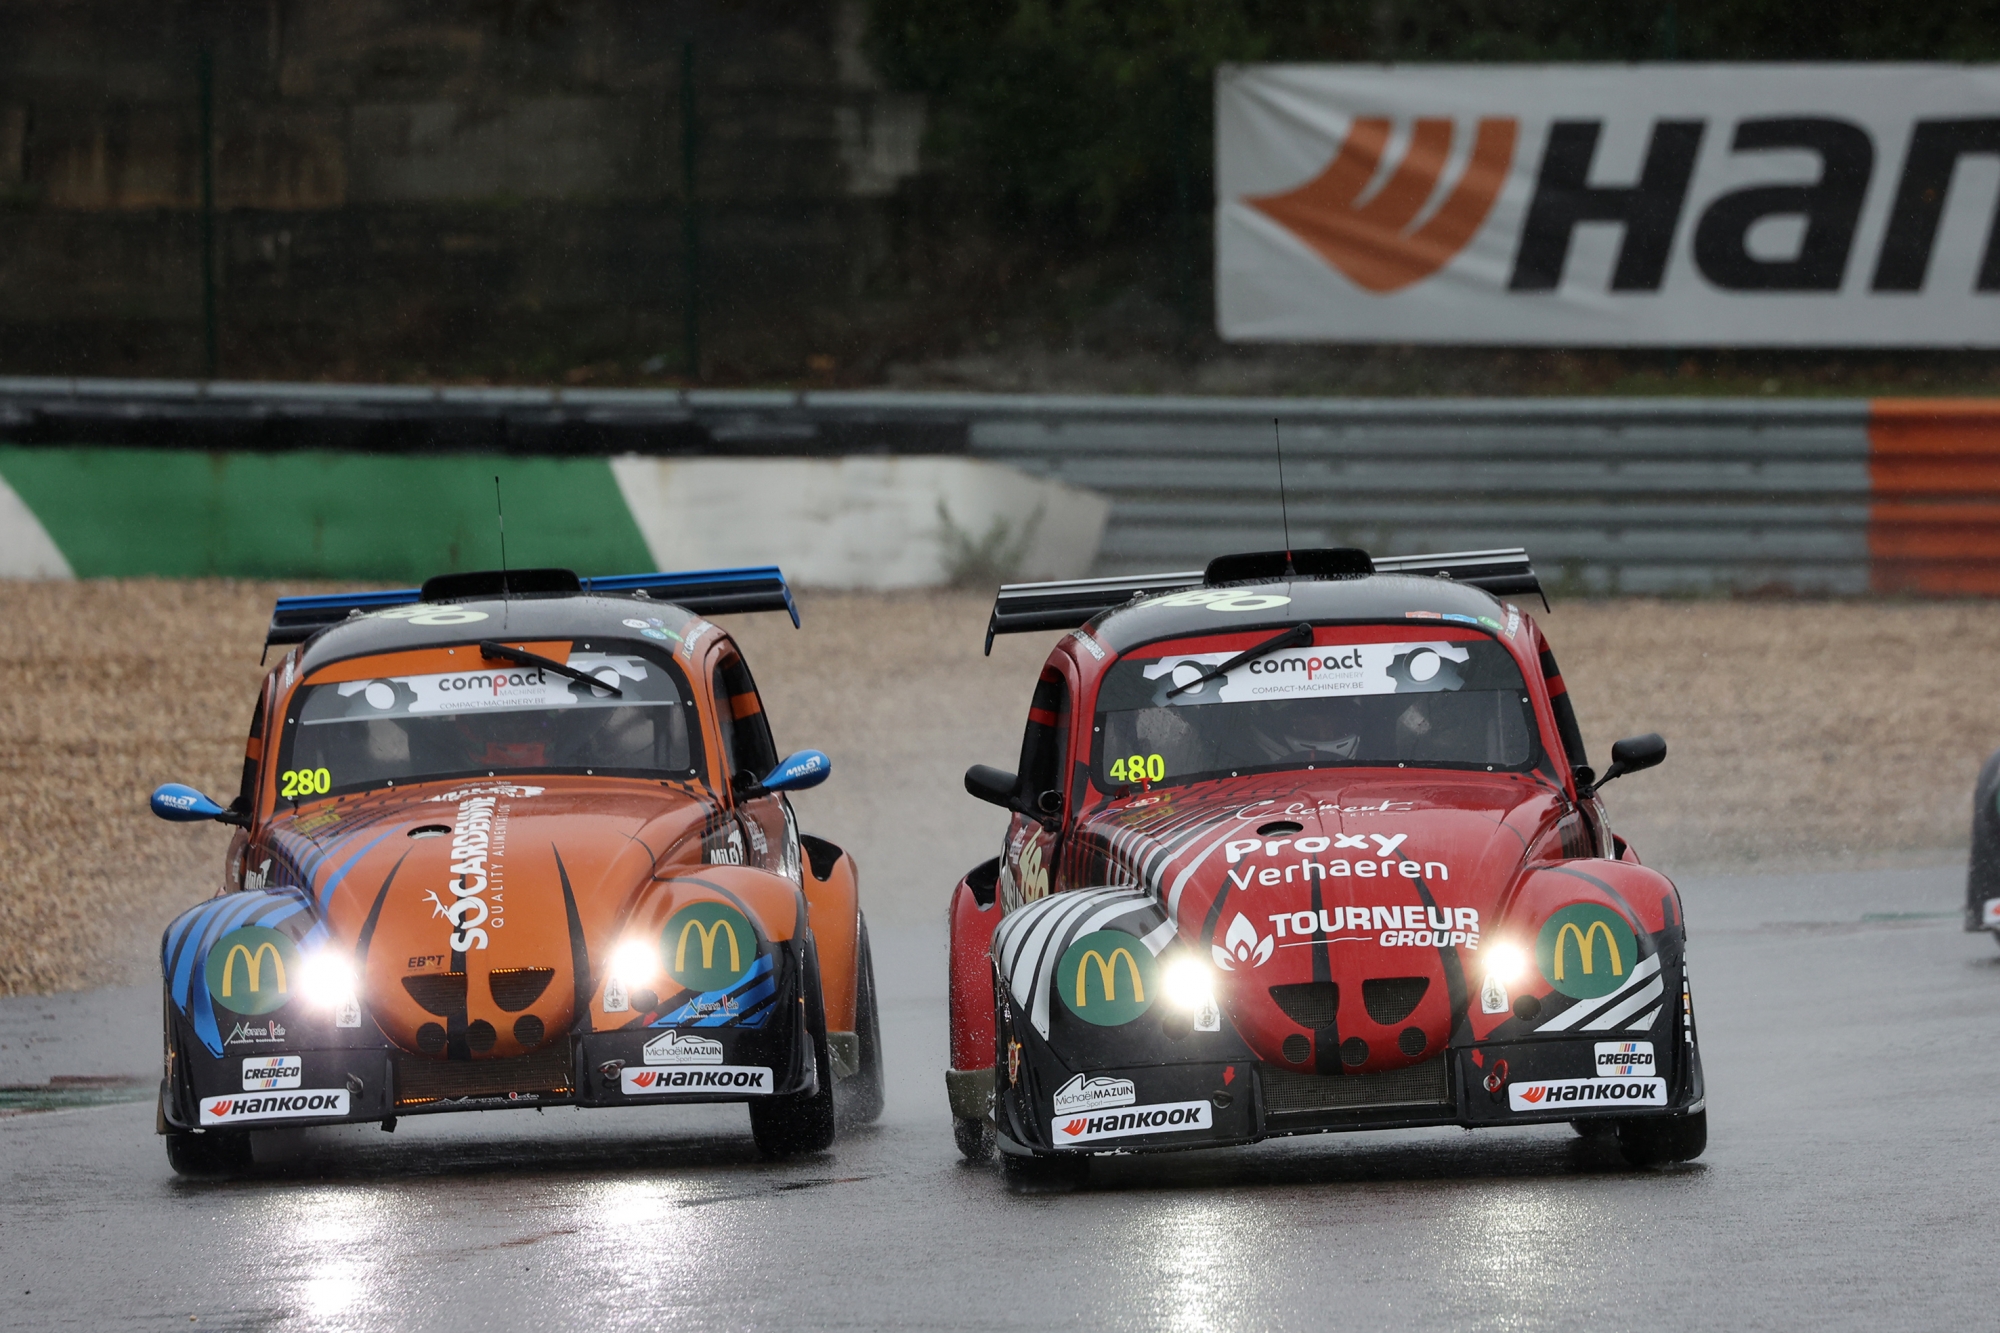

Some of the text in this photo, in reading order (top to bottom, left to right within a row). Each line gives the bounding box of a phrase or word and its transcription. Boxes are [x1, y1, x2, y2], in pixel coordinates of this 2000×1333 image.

[1249, 648, 1363, 681] compact
[438, 667, 546, 697] compact
[1314, 671, 1364, 681] MACHINERY
[500, 687, 547, 697] MACHINERY
[1251, 681, 1364, 694] COMPACT-MACHINERY.BE
[440, 697, 546, 710] COMPACT-MACHINERY.BE
[1110, 753, 1165, 783] 480
[281, 767, 331, 797] 280
[448, 796, 497, 952] SOCARDENNE
[1227, 858, 1449, 891] Verhaeren
[491, 863, 505, 928] QUALITY
[1269, 905, 1480, 938] TOURNEUR
[1379, 929, 1481, 950] GROUPE
[675, 1054, 692, 1063] Sport
[1597, 1053, 1653, 1066] CREDECO
[244, 1066, 300, 1080] CREDECO
[1086, 1100, 1103, 1109] Sport
